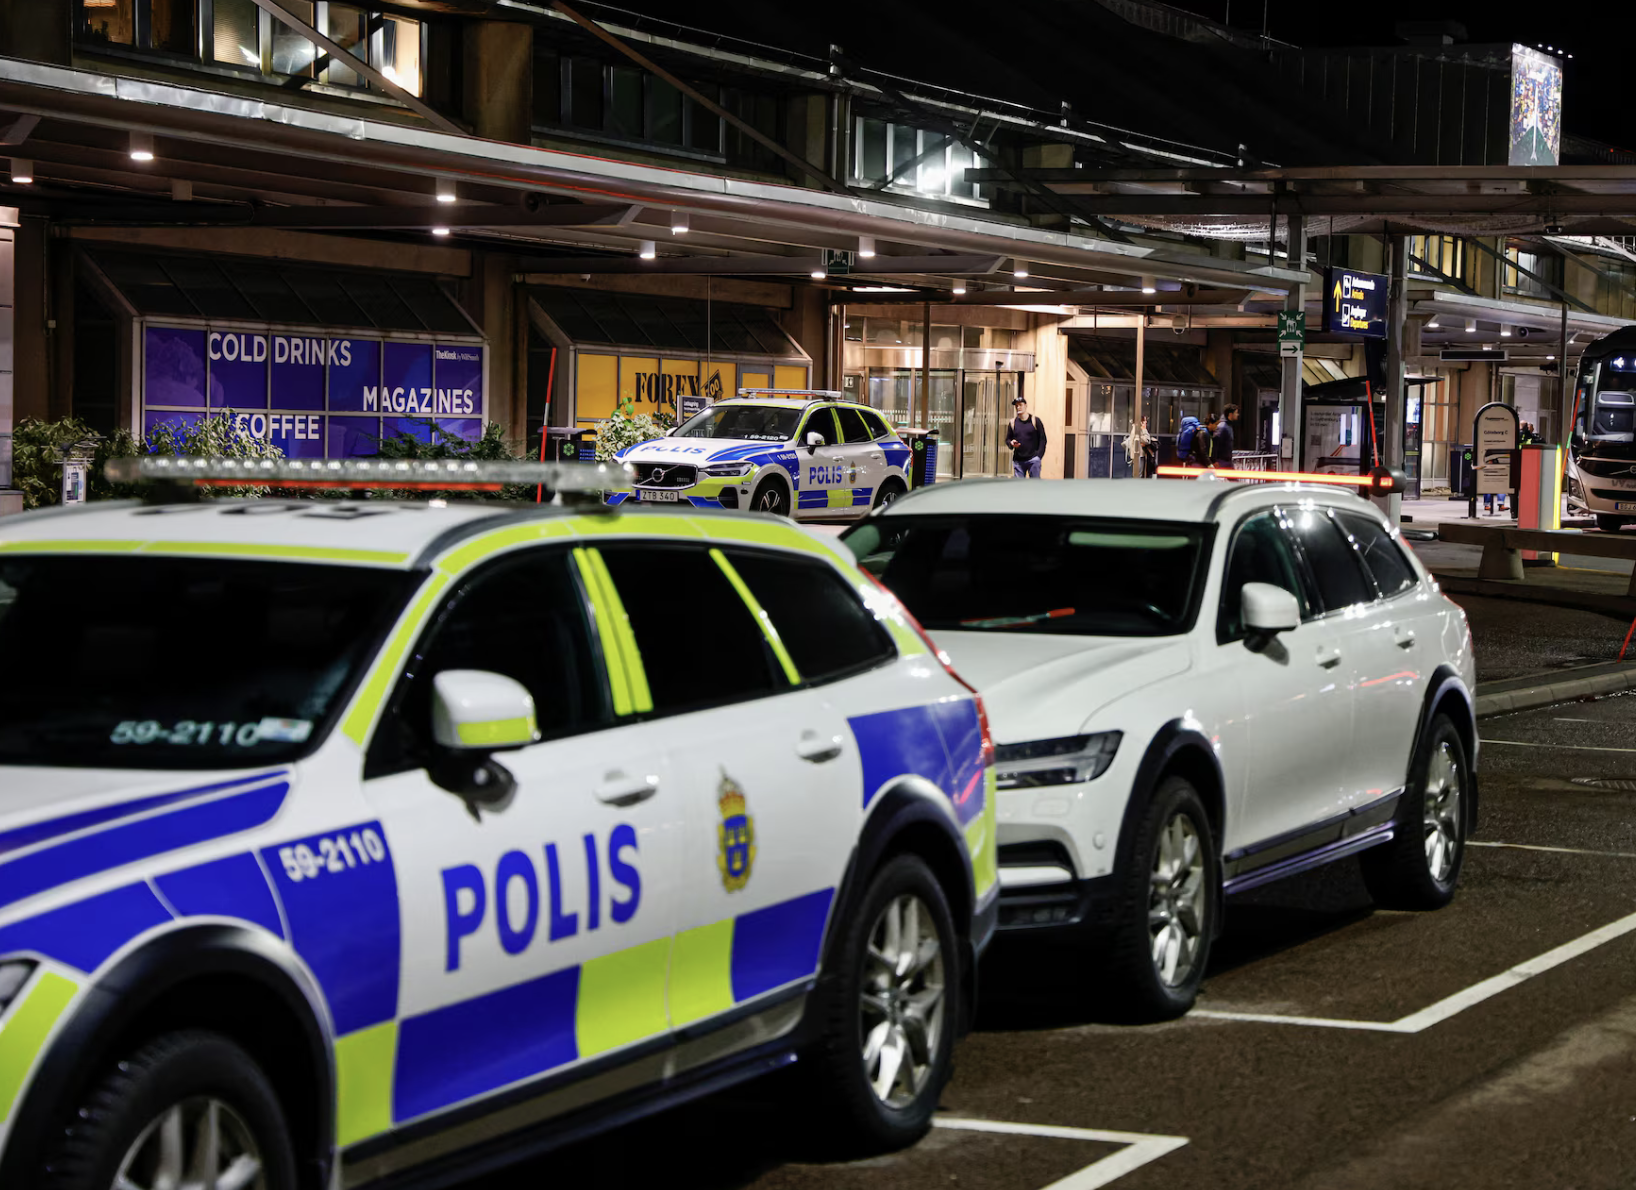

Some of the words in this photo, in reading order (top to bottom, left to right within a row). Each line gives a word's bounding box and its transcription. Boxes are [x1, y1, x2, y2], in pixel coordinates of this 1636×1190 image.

[209, 332, 267, 363] COLD
[274, 336, 352, 367] DRINKS
[362, 385, 474, 414] MAGAZINES
[236, 413, 320, 440] COFFEE
[809, 465, 842, 485] POLIS
[642, 491, 657, 499] ZTB
[659, 492, 675, 500] 340
[110, 720, 259, 746] 59-2110
[278, 828, 386, 882] 59-2110
[441, 823, 642, 973] POLIS
